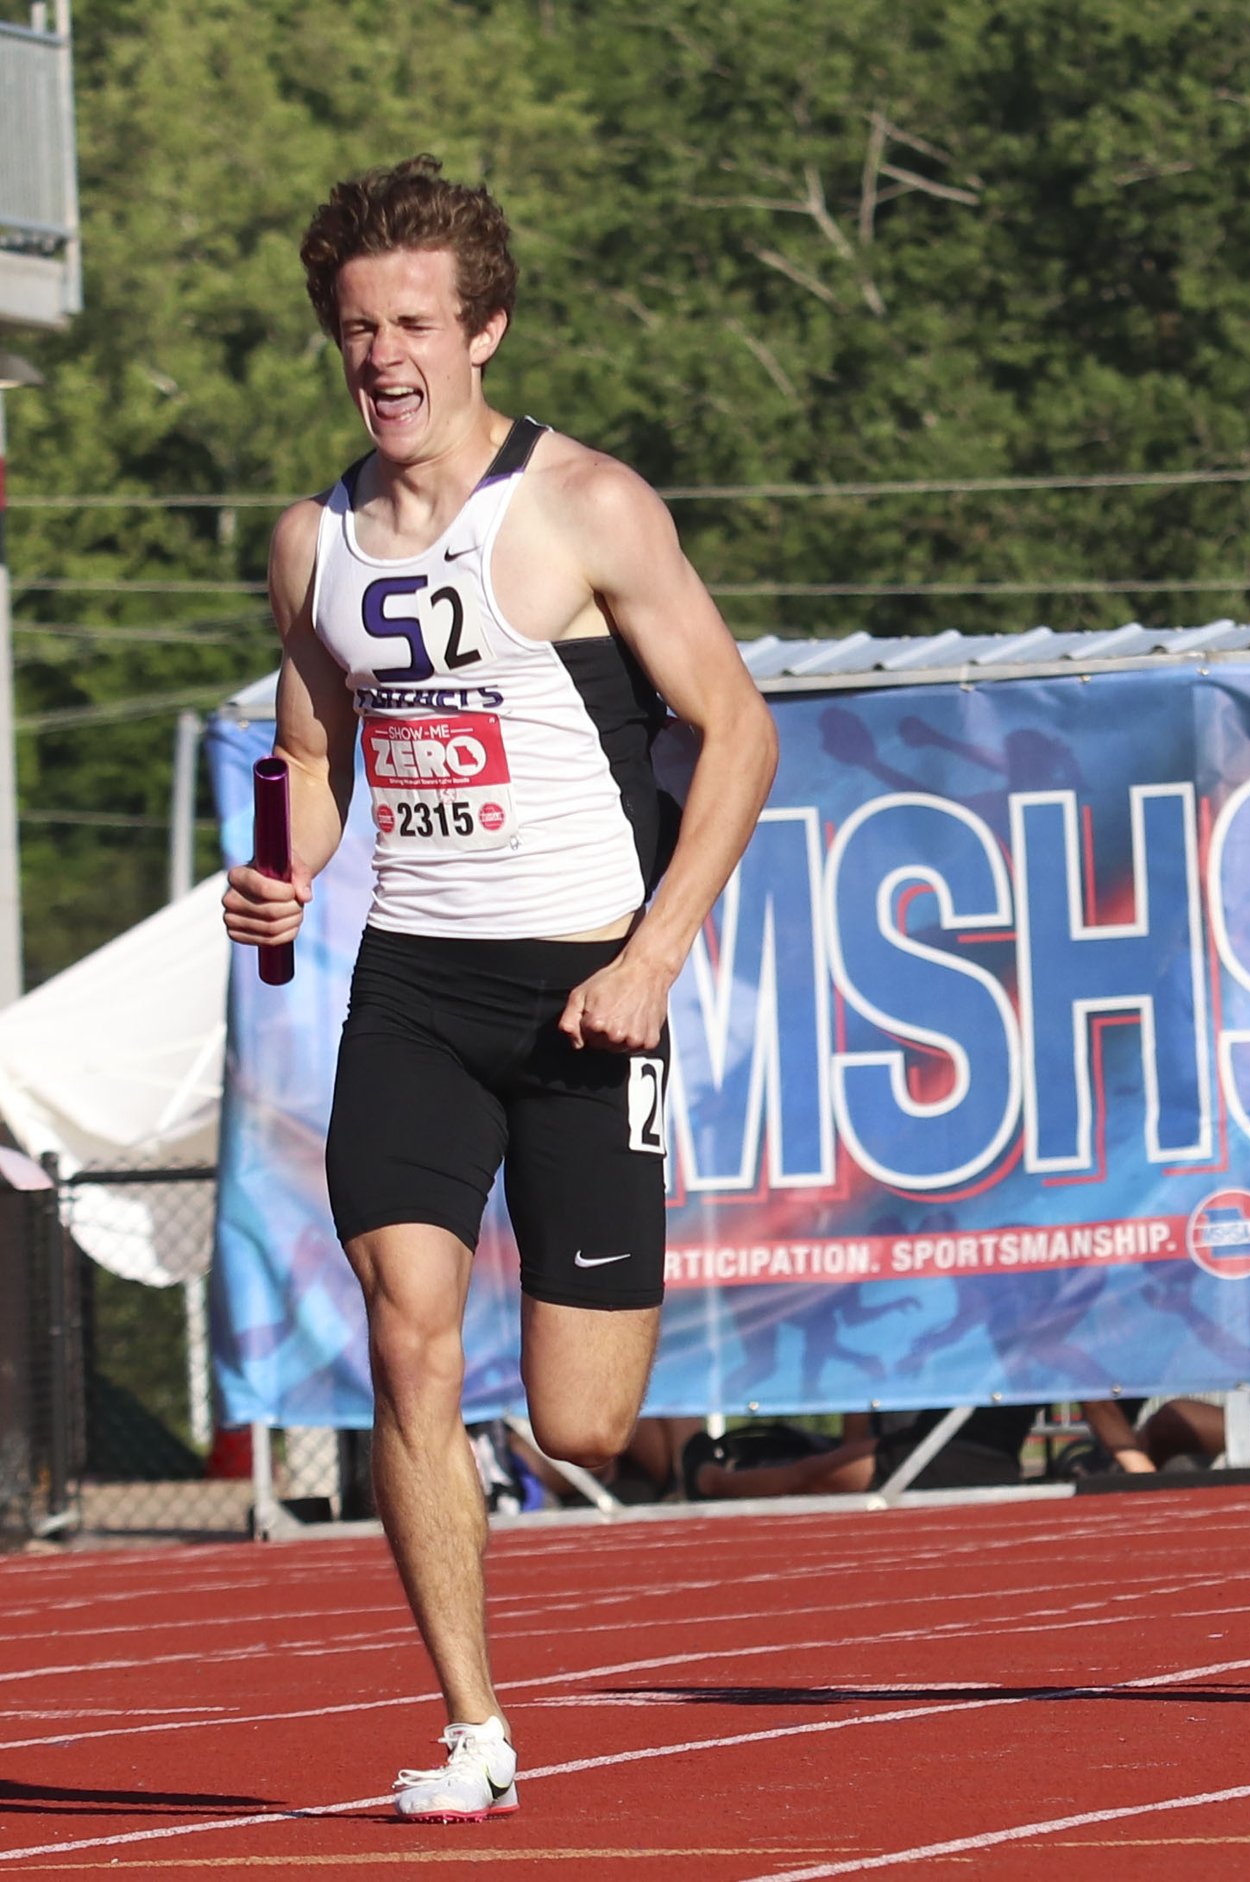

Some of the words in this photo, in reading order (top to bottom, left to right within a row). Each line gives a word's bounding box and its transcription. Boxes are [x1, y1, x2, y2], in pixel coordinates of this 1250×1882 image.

[361, 574, 435, 683] S
[430, 586, 482, 670] 2
[370, 735, 487, 778] ZERO
[388, 724, 450, 740] SHOW-ME
[398, 801, 474, 837] 2315
[641, 1063, 660, 1147] 2
[664, 1245, 879, 1281] RTICIPATION.
[892, 1222, 1176, 1271] SPORTSMANSHIP.
